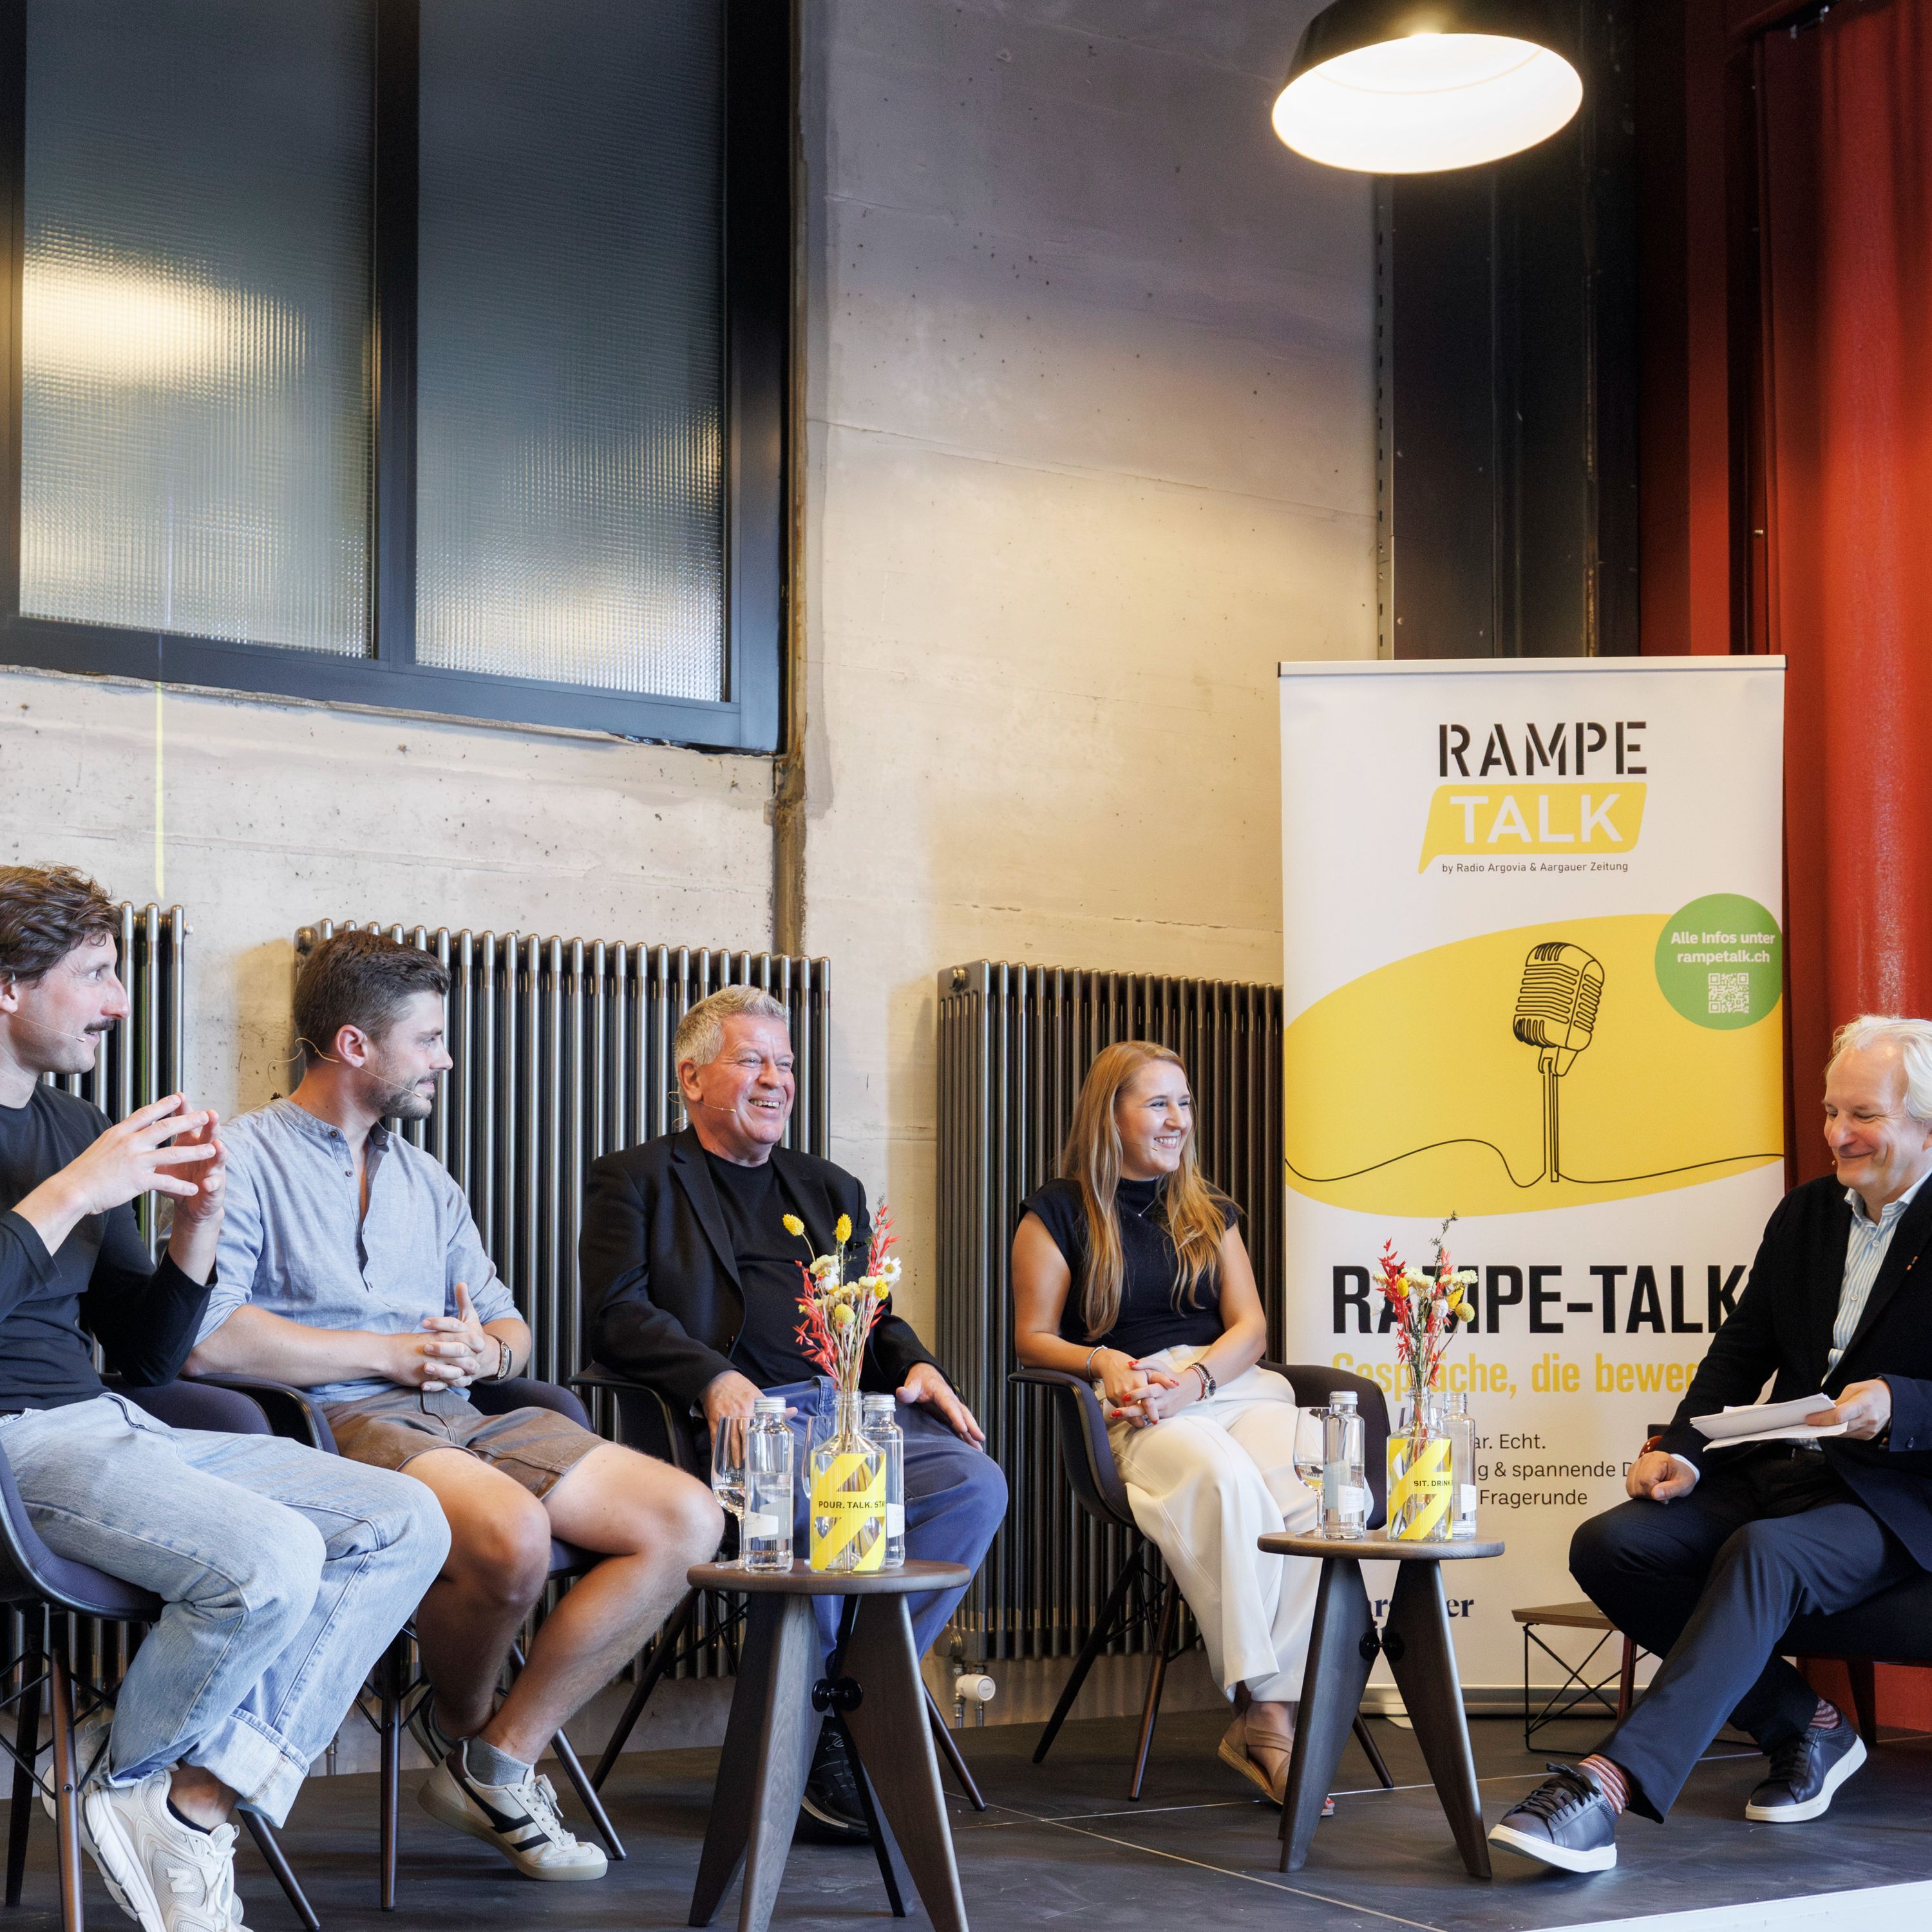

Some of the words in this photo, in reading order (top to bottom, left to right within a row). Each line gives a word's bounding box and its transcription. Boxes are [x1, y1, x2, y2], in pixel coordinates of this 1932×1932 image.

[1439, 721, 1647, 777] RAMPE
[1450, 793, 1623, 844] TALK
[1442, 864, 1454, 874] by
[1457, 863, 1484, 872] Radio
[1488, 862, 1526, 873] Argovia
[1530, 862, 1537, 871] &
[1540, 862, 1587, 873] Aargauer
[1591, 862, 1628, 872] Zeitung
[1671, 931, 1698, 944] Alle
[1702, 931, 1737, 943] Infos
[1741, 933, 1776, 944] unter
[1677, 950, 1770, 965] rampetalk.ch
[1332, 1352, 1516, 1401] espäche,
[1531, 1353, 1579, 1392] die
[1499, 1434, 1546, 1449] Echt.
[1494, 1461, 1506, 1477] &
[1512, 1461, 1616, 1481] spannende
[819, 1501, 845, 1509] POUR.
[1480, 1489, 1588, 1508] Fragerunde
